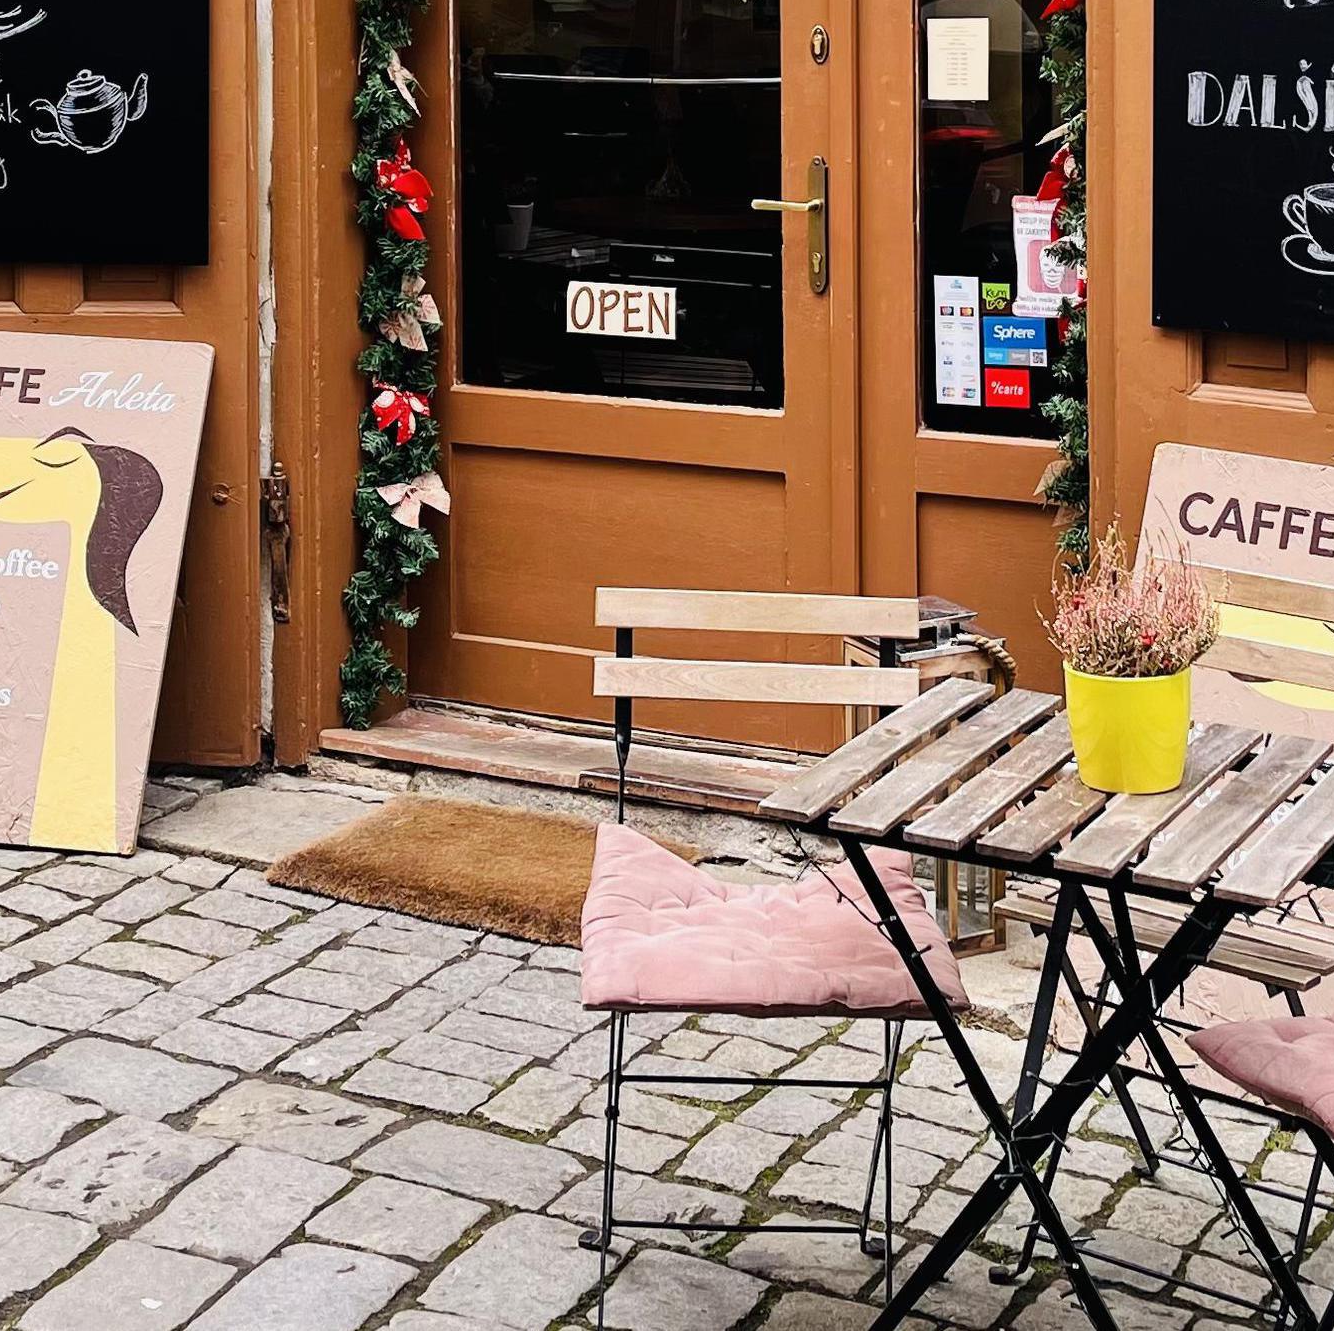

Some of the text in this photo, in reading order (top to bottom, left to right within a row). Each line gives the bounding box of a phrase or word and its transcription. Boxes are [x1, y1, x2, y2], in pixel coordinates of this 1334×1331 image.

[570, 285, 670, 335] OPEN
[993, 324, 1036, 340] Sphere
[48, 370, 177, 413] Arleta
